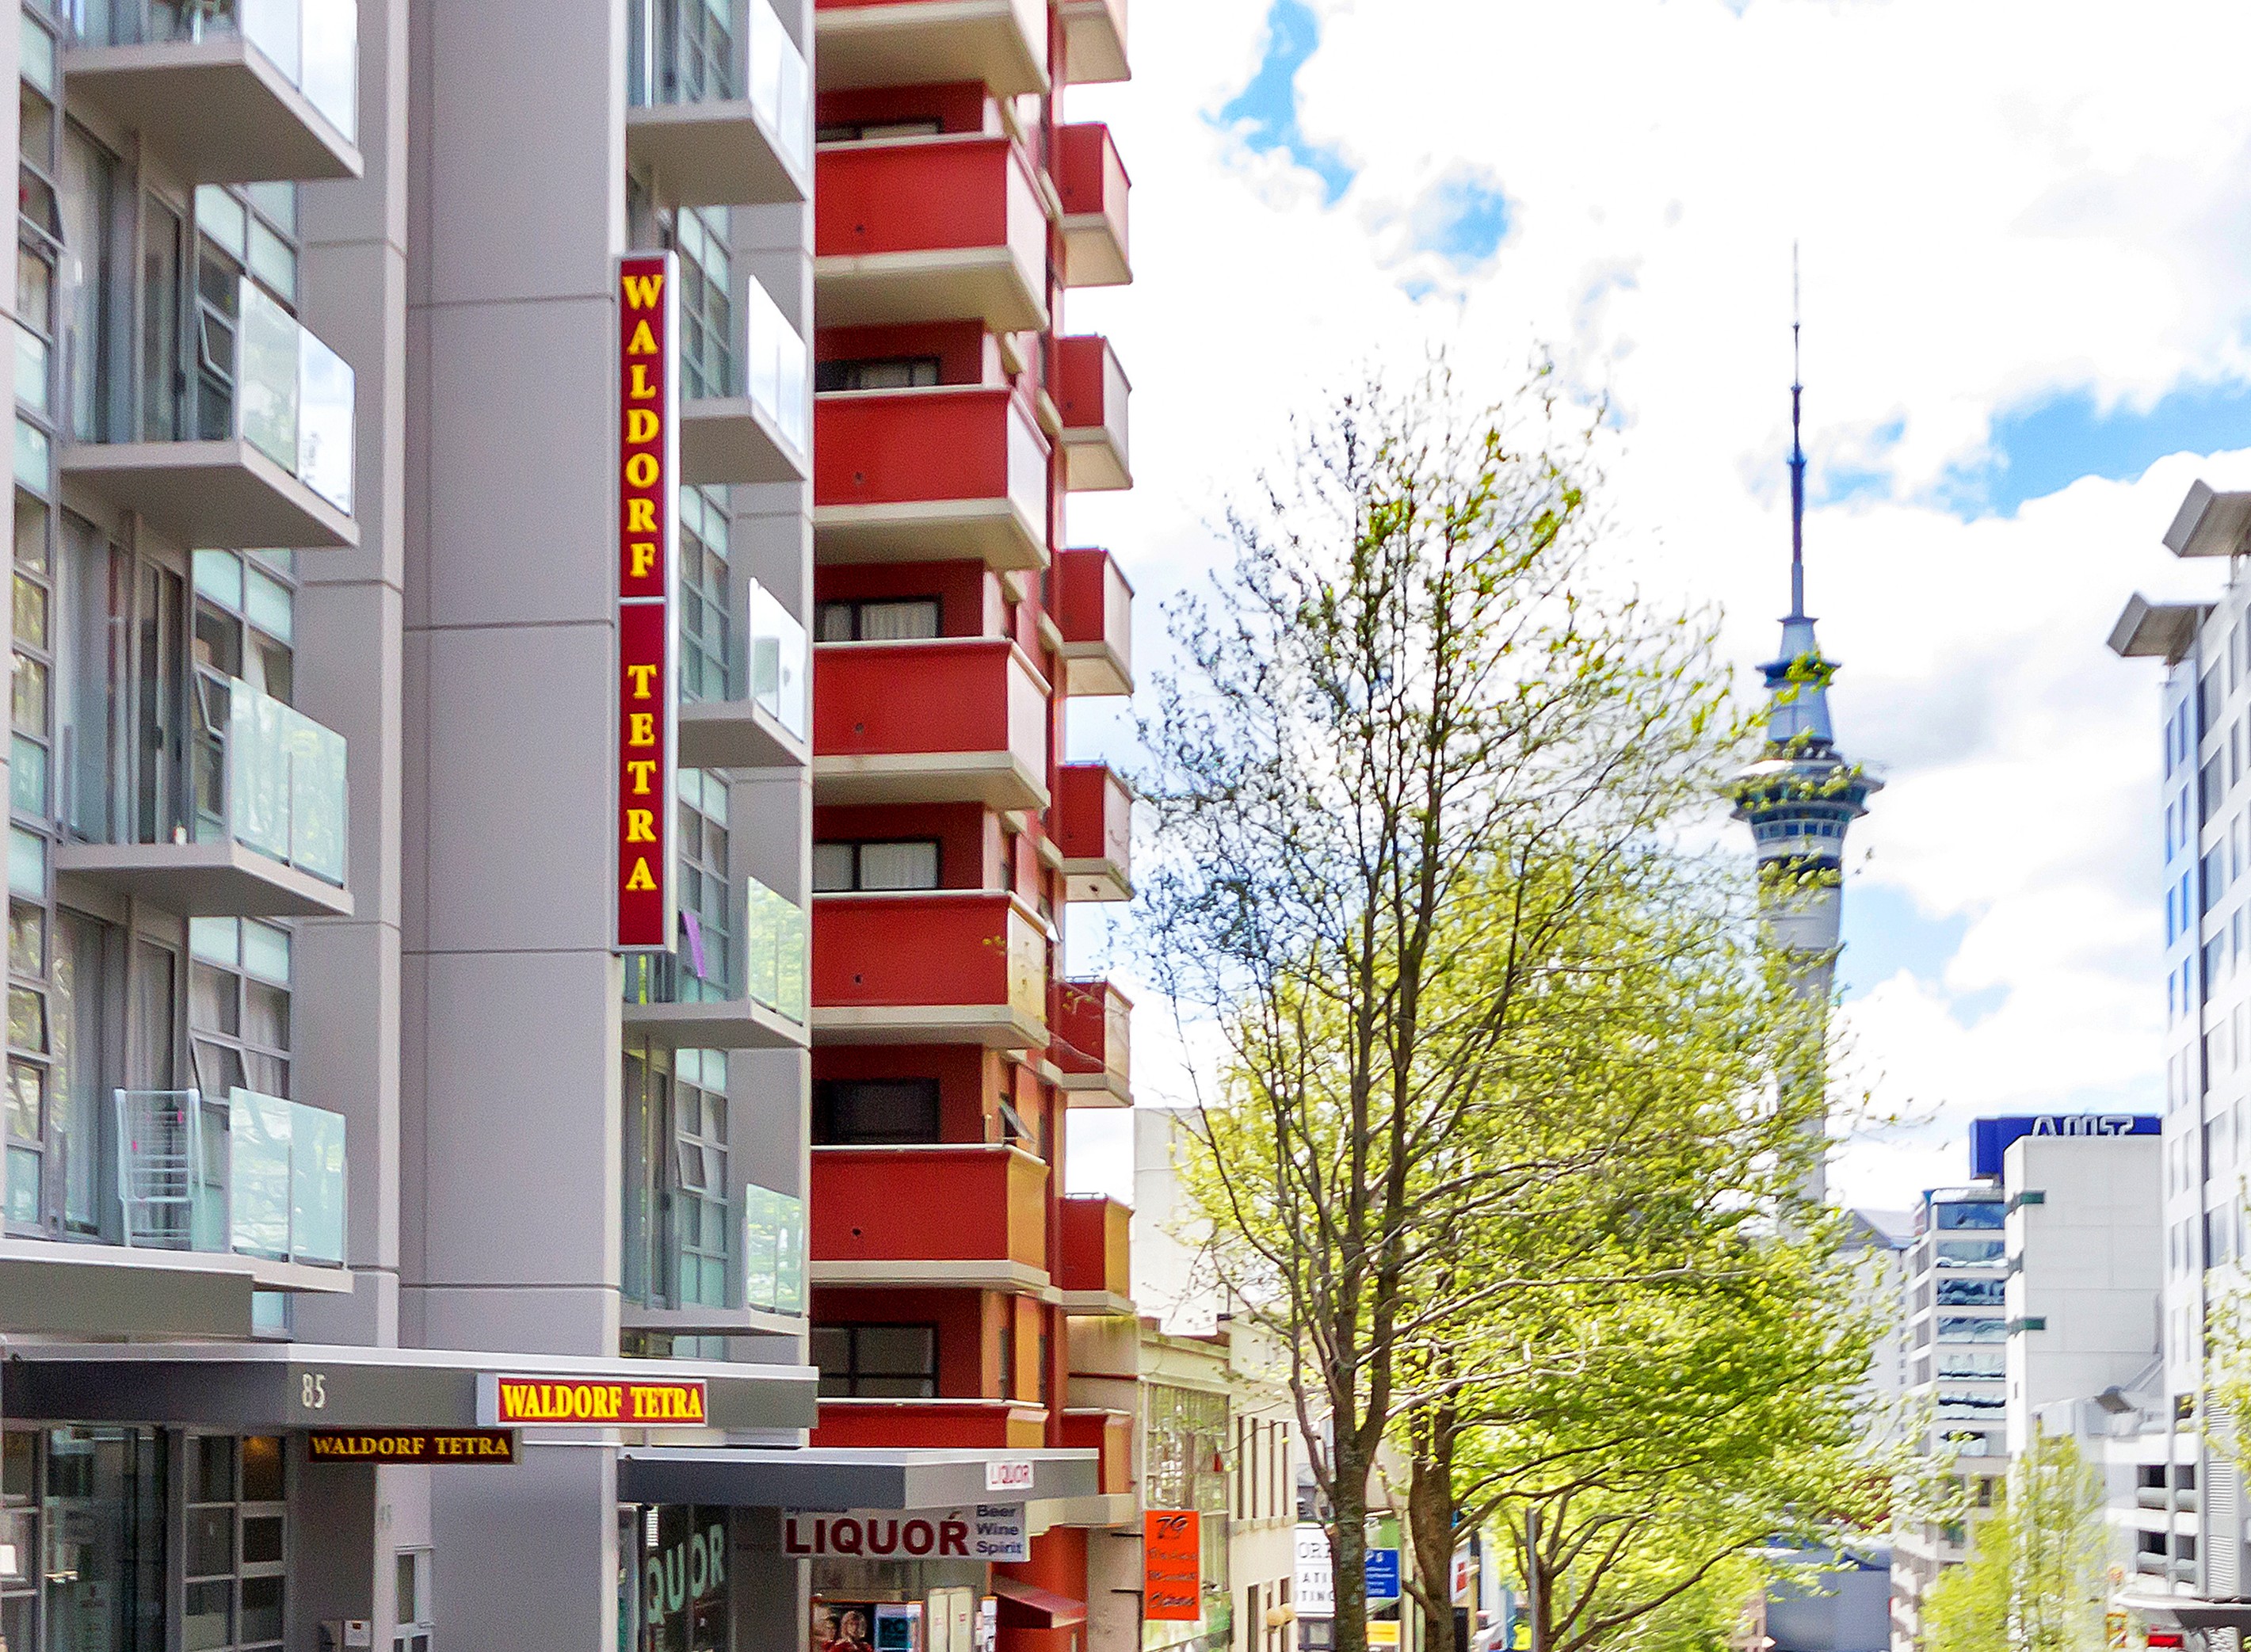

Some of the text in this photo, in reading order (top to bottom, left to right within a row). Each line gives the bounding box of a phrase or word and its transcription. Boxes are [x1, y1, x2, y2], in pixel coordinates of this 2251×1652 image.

[622, 275, 663, 577] WALDORF
[626, 664, 658, 891] TETRA
[302, 1372, 326, 1409] 85
[501, 1384, 704, 1418] WALDORF TETRA
[312, 1436, 509, 1455] WALDORF TETRA
[975, 1505, 1016, 1517] Beer
[1156, 1515, 1188, 1539] 79
[785, 1518, 970, 1556] LIQUOR
[976, 1523, 1019, 1536] Wine
